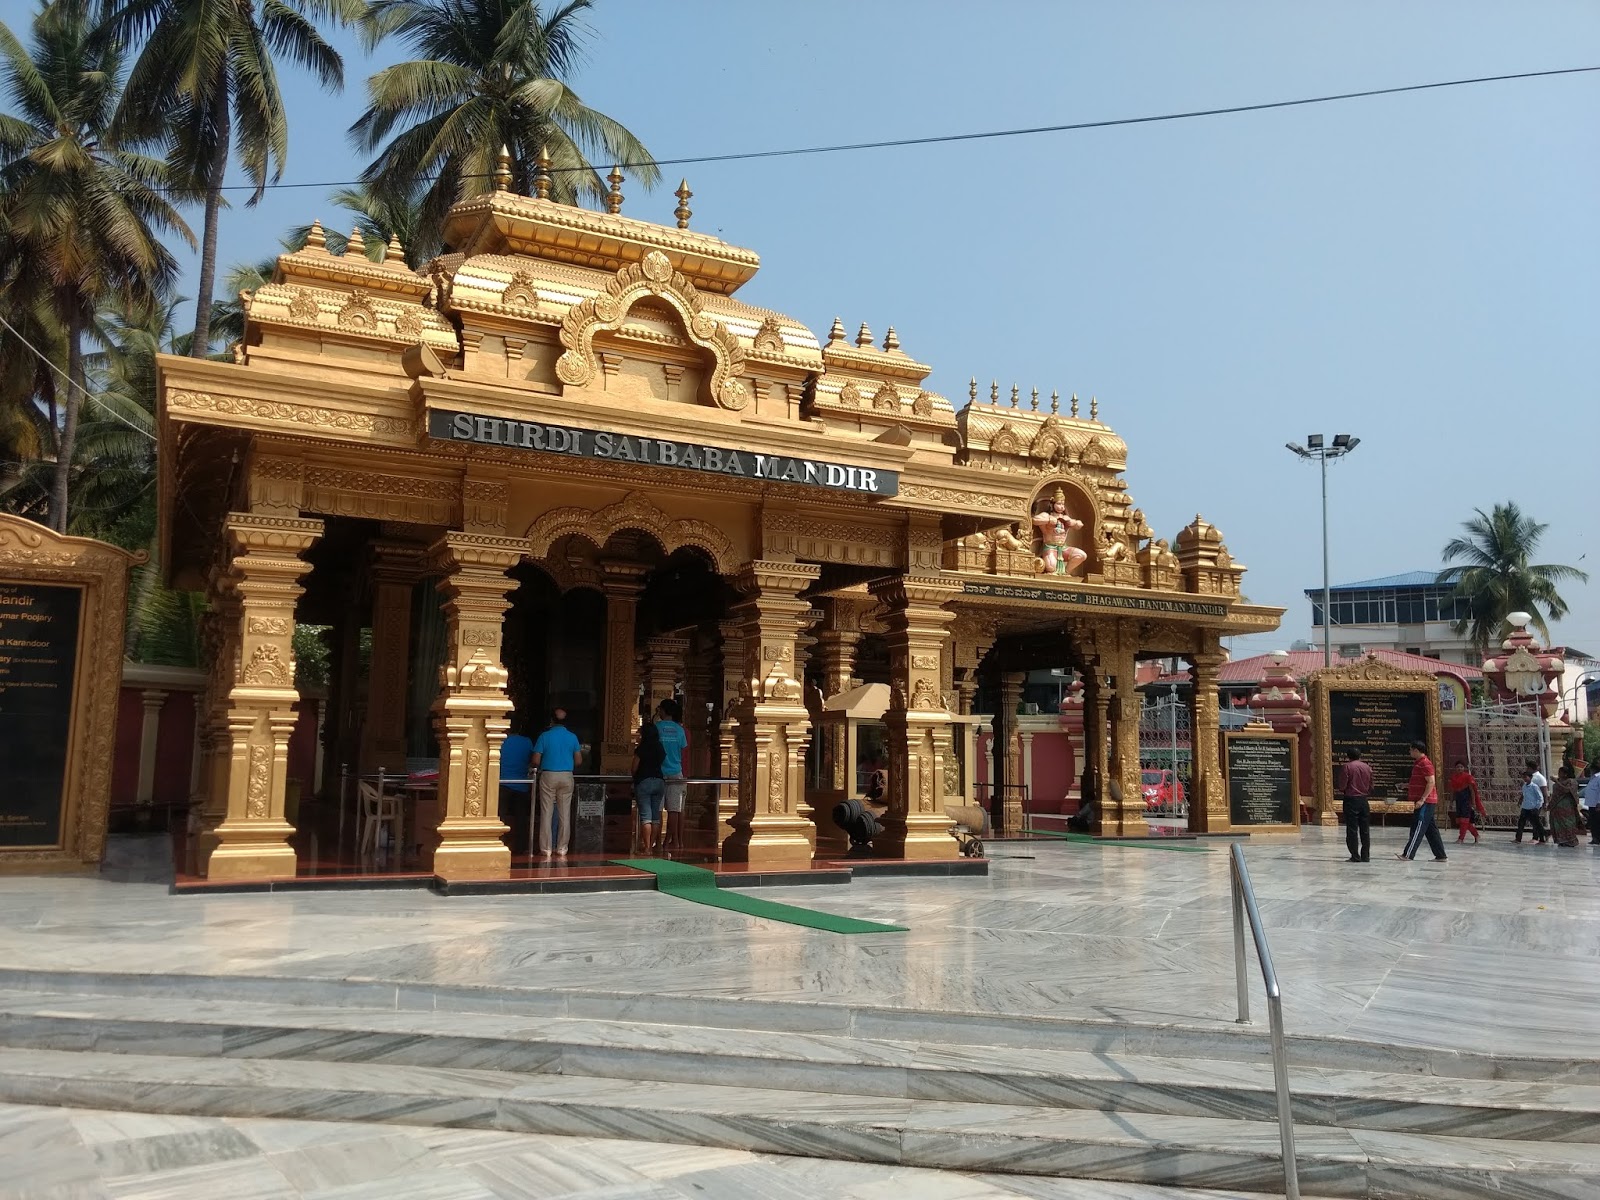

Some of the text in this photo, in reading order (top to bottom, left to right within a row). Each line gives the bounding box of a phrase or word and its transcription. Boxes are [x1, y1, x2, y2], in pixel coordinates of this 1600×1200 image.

[453, 412, 879, 492] SHIRDI SAI BABA MANDIR
[964, 584, 1078, 602] ವಾನ್ ಹನುಮಾನ್ ಮಂದಿರ
[1085, 594, 1225, 615] BHAGAWAN HANUMAN MANDIR
[21, 613, 52, 622] Poojary
[6, 639, 51, 647] Karandoor
